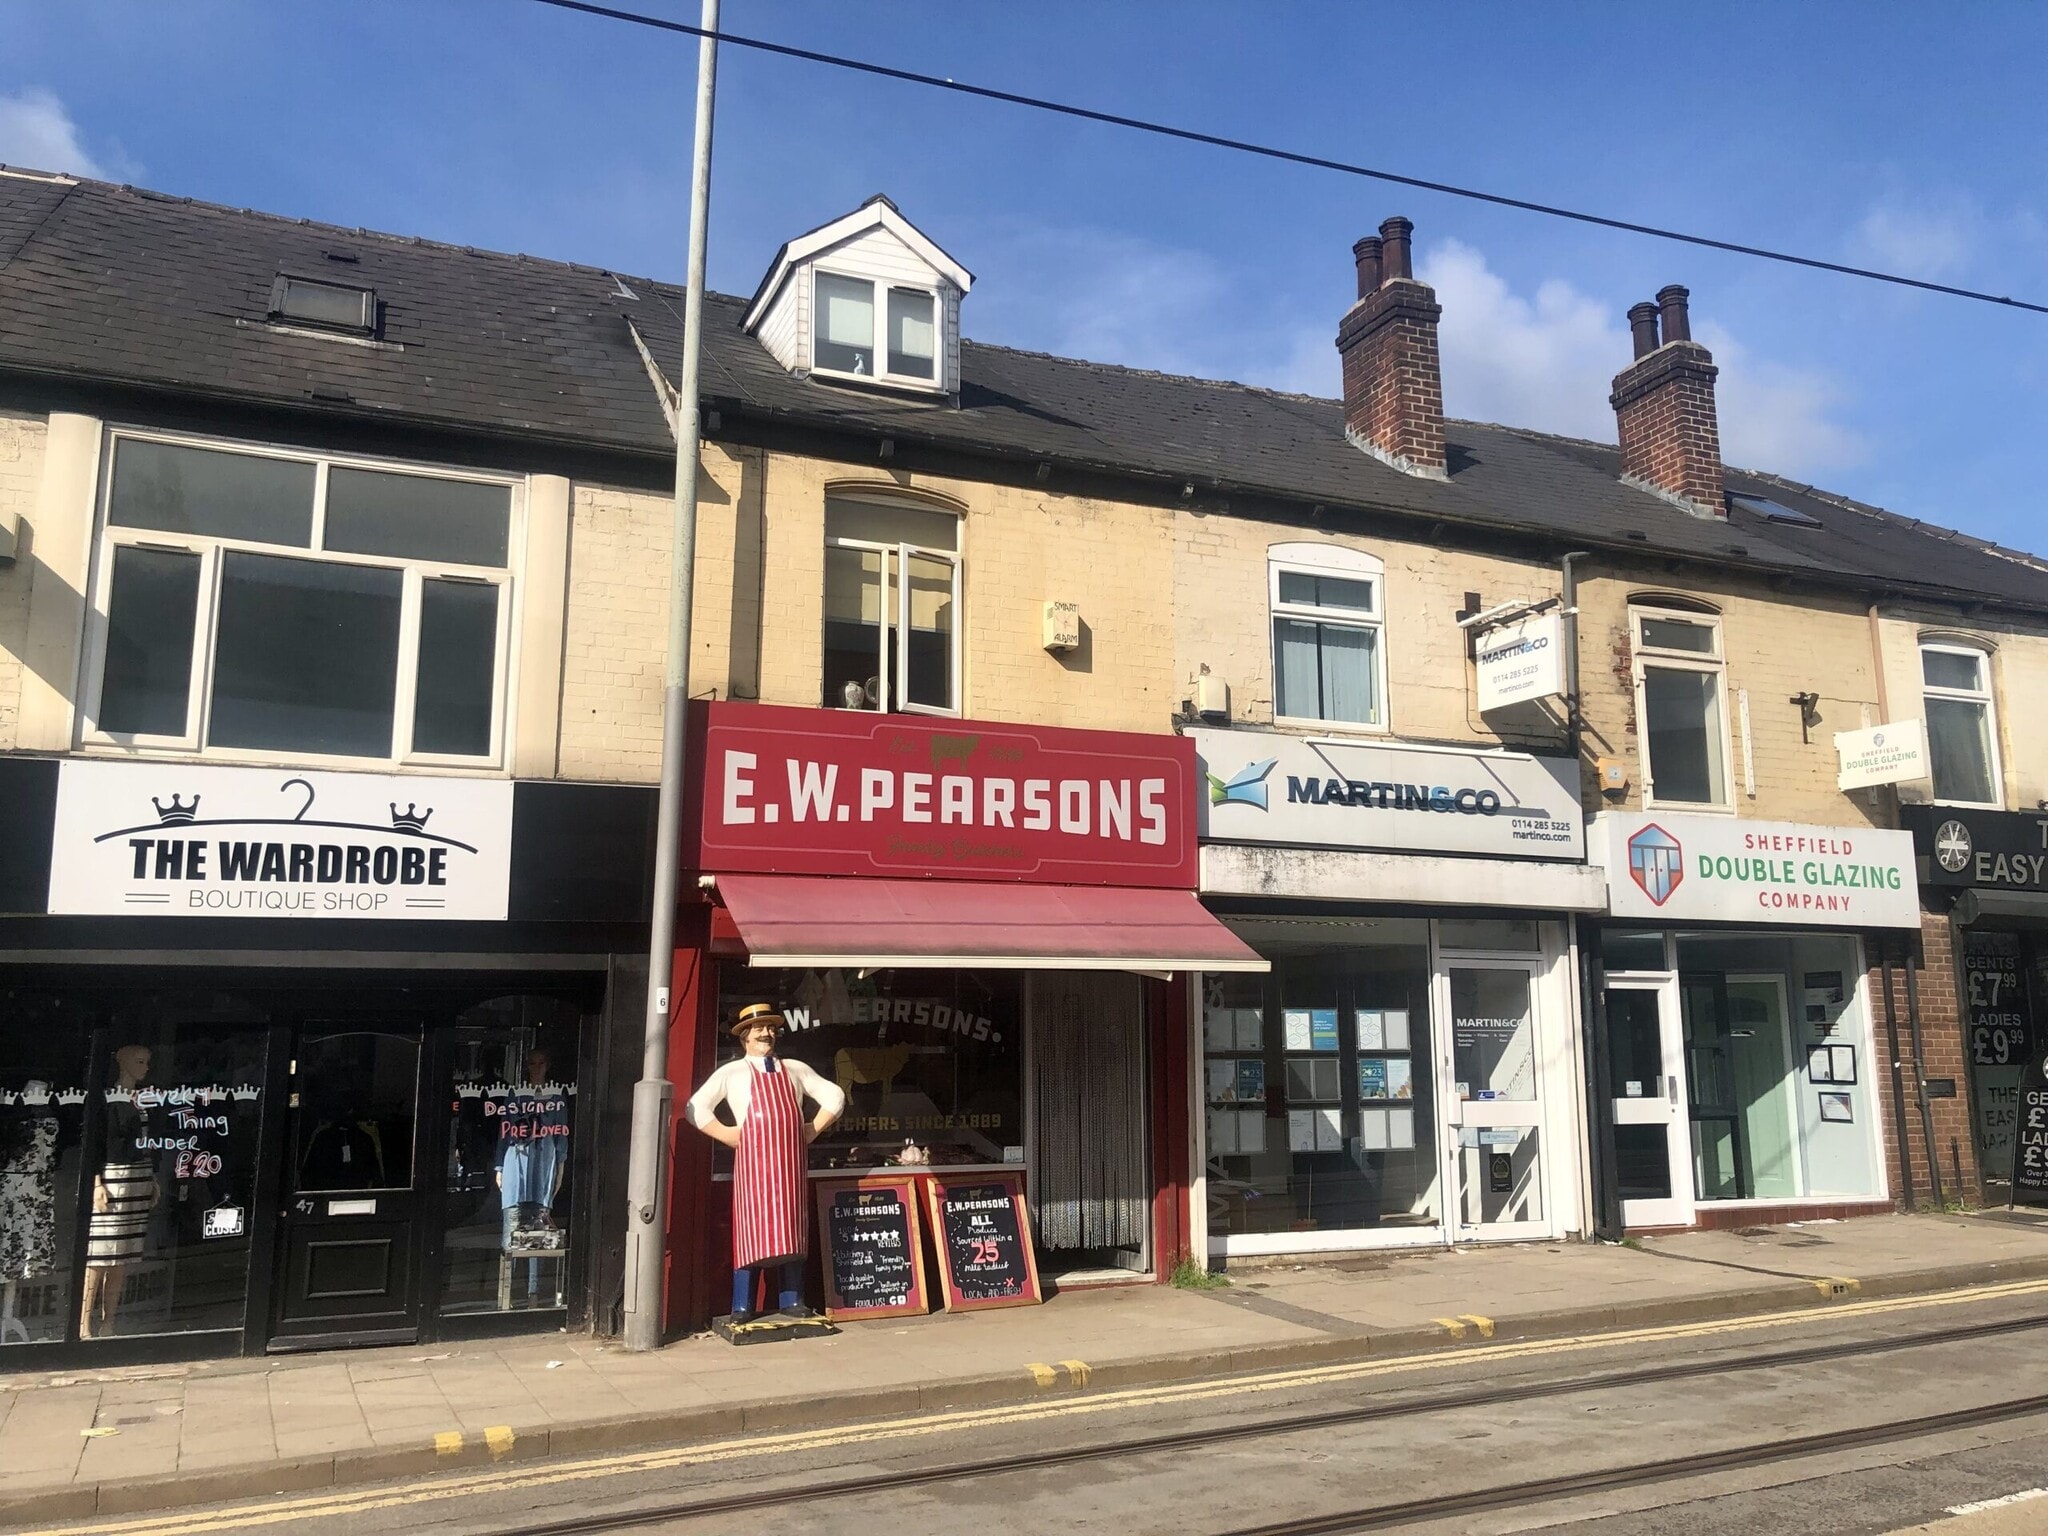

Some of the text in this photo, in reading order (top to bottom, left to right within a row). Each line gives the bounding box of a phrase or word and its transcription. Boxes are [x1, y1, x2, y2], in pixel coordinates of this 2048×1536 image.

[1054, 601, 1078, 612] SMART
[1054, 633, 1078, 643] ALARM
[1482, 637, 1548, 665] MARTIN&CO
[1493, 665, 1539, 684] 0114 285 5225
[1498, 680, 1535, 694] martinco.com
[1846, 751, 1917, 769] DOUBLE GLAZING
[1861, 746, 1899, 757] SHEFFIELD
[1866, 764, 1898, 773] COMPANY
[723, 749, 1166, 846] E.W.PEARSONS
[1287, 775, 1502, 816] MARTIN&CO
[1512, 819, 1571, 832] 0114 285 5225
[1512, 830, 1571, 842] martinco.com
[1745, 833, 1853, 855] SHEFFIELD
[129, 838, 447, 886] THE WARDROBE
[1975, 852, 2045, 885] EASY
[1699, 854, 1901, 890] DOUBLE GLAZING
[188, 889, 388, 911] BOUTIQUE SHOP
[1759, 891, 1850, 911] COMPANY
[1966, 957, 2015, 969] GENTS
[1969, 970, 2017, 1007] £7.99
[659, 997, 666, 1007] 6
[1971, 1013, 2021, 1026] LADIES
[1973, 1027, 2024, 1064] £9.99
[1987, 1087, 2017, 1104] THE
[905, 1115, 954, 1130] SINCE
[959, 1113, 1001, 1128] 1889
[1985, 1110, 2015, 1127] EAS
[501, 1121, 570, 1139] PRE LOVED
[135, 1135, 201, 1151] UNDER
[174, 1151, 222, 1178] £20
[2026, 1169, 2043, 1177] Over
[2019, 1177, 2041, 1187] Happy
[296, 1199, 314, 1216] 47
[835, 1203, 900, 1219] E.W.PEARSONS
[947, 1197, 1010, 1213] E.W.PEARSONS
[971, 1215, 993, 1226] ALL
[971, 1241, 999, 1264] 25
